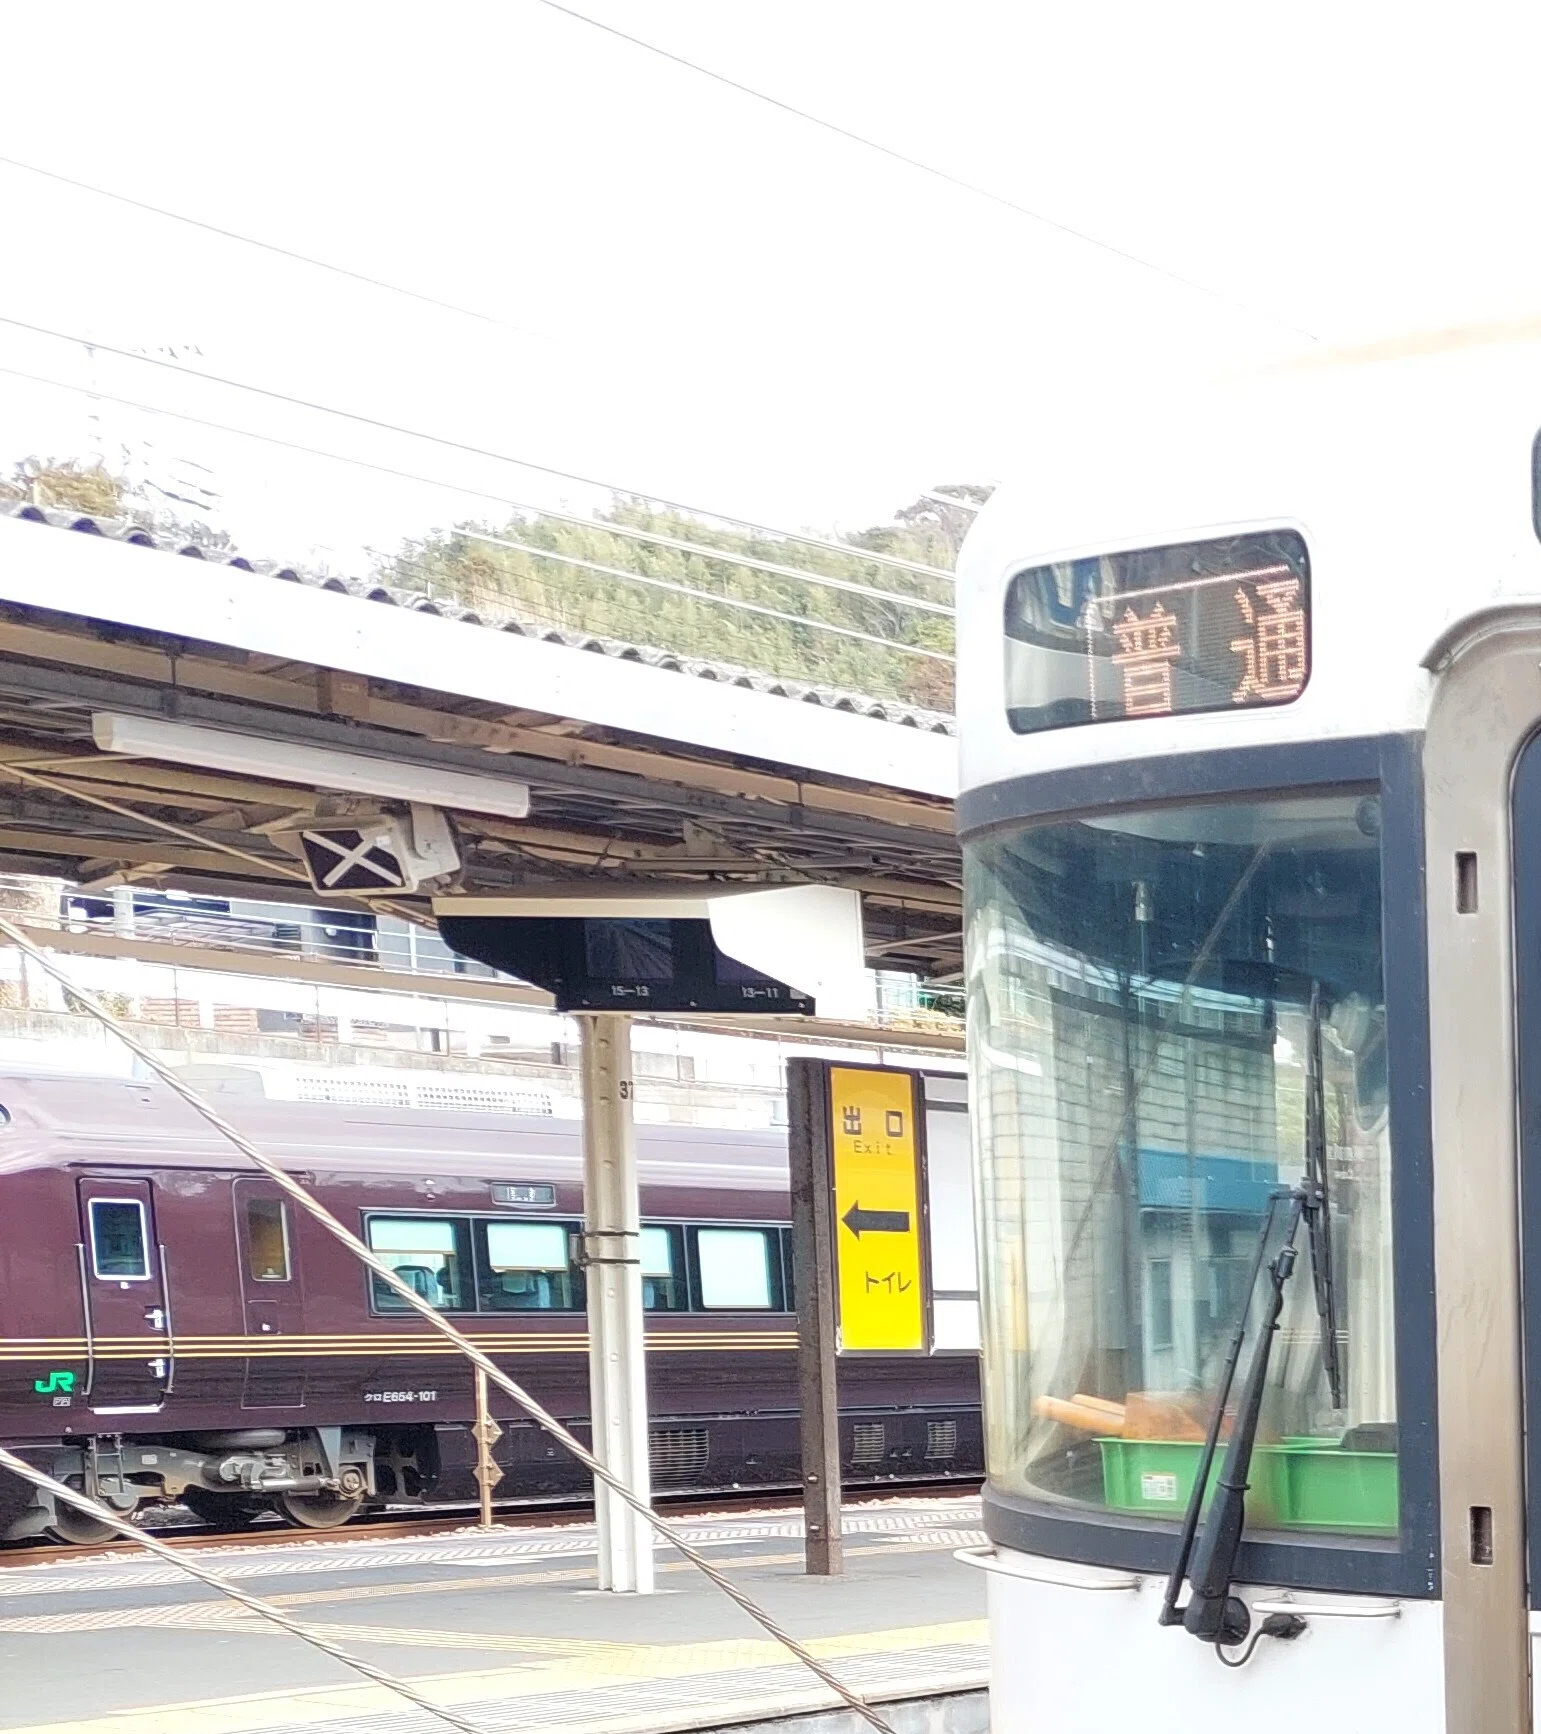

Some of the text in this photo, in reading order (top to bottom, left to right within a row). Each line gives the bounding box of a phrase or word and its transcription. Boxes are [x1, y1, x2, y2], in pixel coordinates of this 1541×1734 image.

[1112, 576, 1304, 716] 普通
[842, 1105, 904, 1138] 出口
[853, 1140, 893, 1156] Exit
[865, 1271, 912, 1294] トイレ
[35, 1372, 74, 1393] JR
